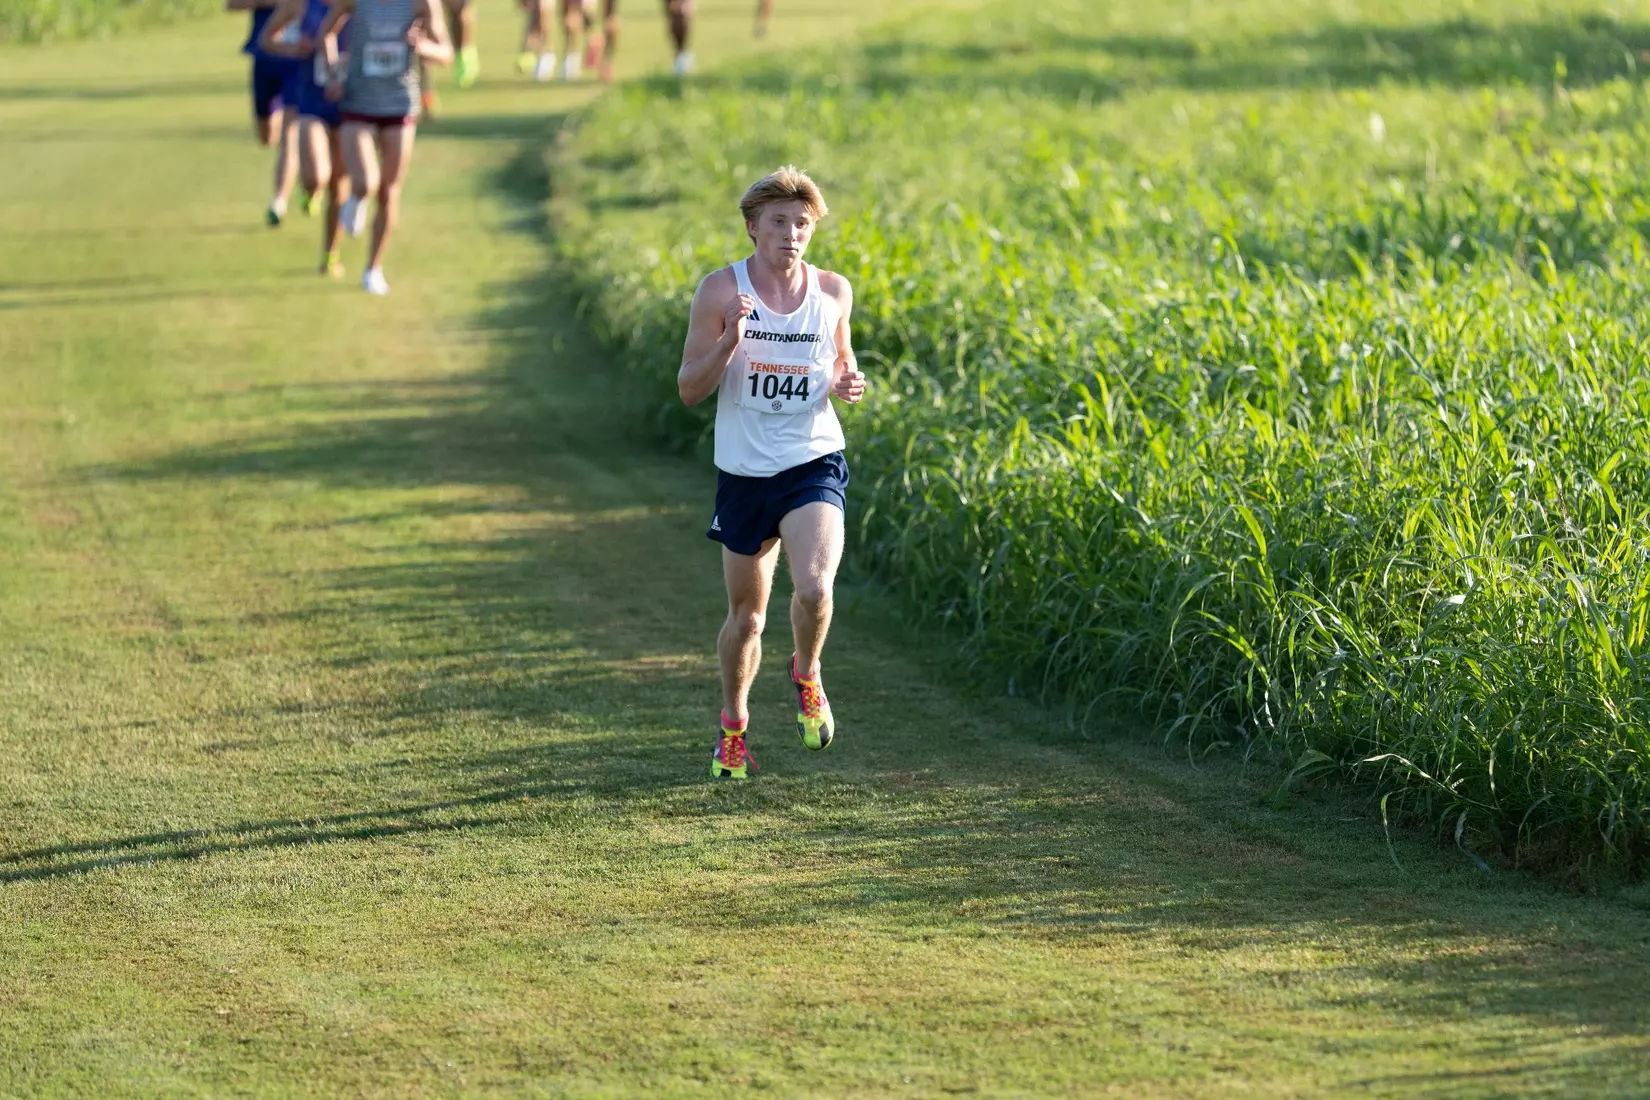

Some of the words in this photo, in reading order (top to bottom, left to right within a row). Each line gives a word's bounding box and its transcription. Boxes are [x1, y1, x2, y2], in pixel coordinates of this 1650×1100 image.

[744, 329, 822, 343] CHATTANOOGA
[750, 362, 809, 375] TENNESSEE
[748, 373, 809, 401] 1044
